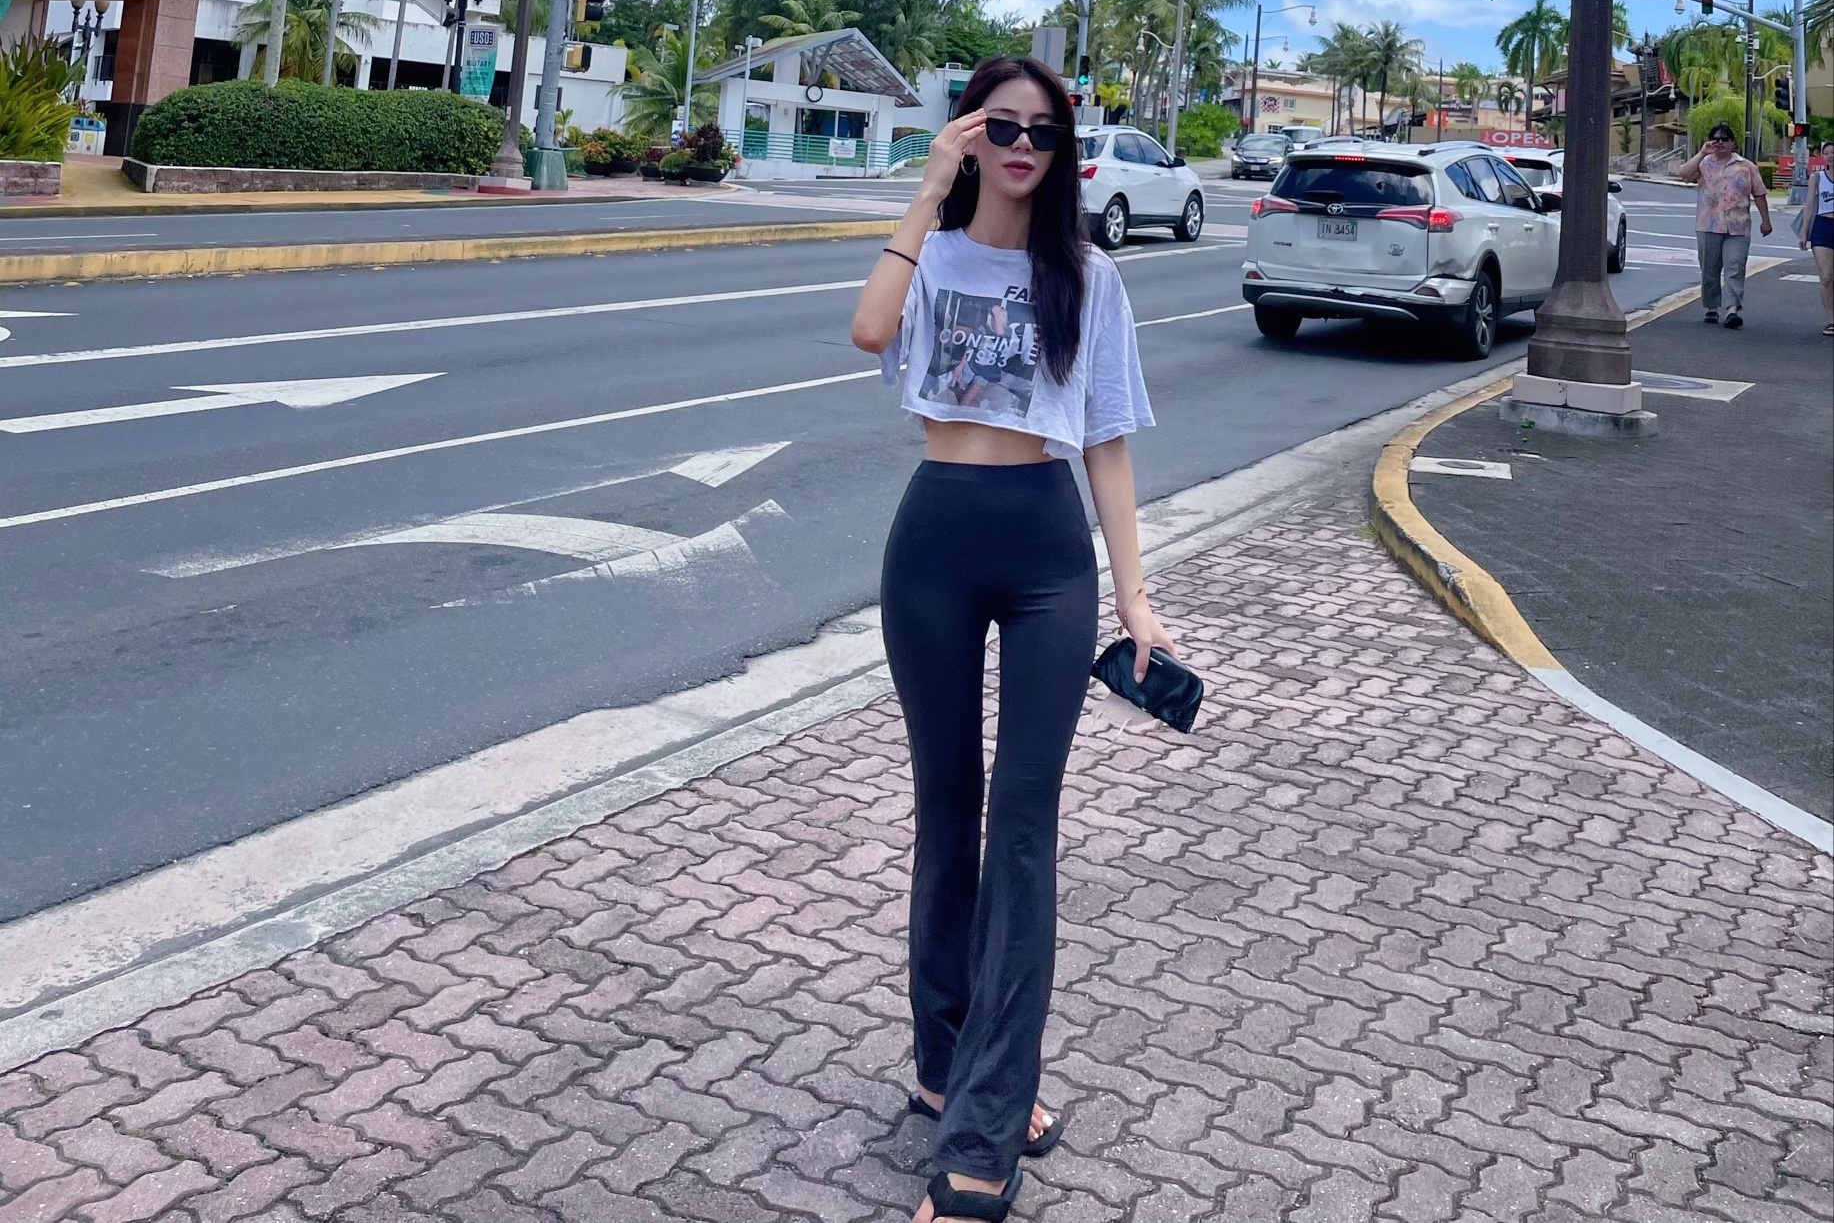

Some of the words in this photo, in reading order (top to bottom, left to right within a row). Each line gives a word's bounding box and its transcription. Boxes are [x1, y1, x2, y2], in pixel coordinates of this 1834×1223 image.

[473, 32, 490, 44] USO
[1492, 131, 1549, 144] OPEN
[1003, 285, 1034, 302] FA
